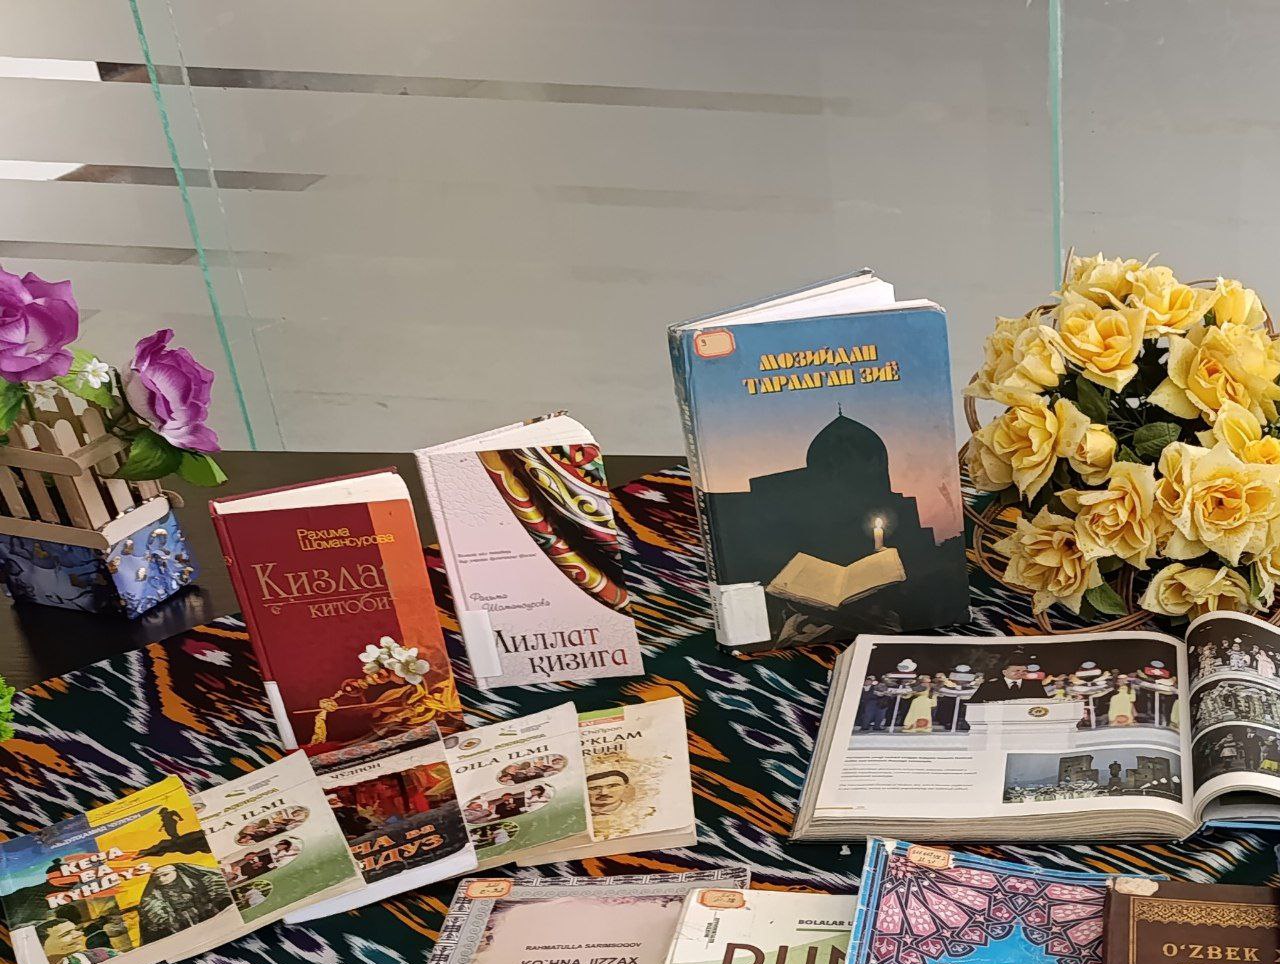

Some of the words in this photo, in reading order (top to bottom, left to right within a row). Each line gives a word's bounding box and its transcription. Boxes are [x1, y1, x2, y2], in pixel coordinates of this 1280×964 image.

[760, 345, 878, 371] МОЗИЙДАН
[742, 369, 855, 395] ТАРАЛГАН
[859, 360, 900, 384] ЗИЁ
[297, 527, 350, 541] Рахима
[300, 533, 395, 551] Шомансурова
[308, 592, 391, 619] китоби
[455, 757, 500, 774] OILA
[507, 744, 549, 760] ILMI
[582, 744, 624, 757] RUHI
[203, 820, 233, 836] ILA
[241, 798, 286, 821] ILMI
[349, 835, 396, 855] ЧА
[357, 834, 446, 872] НДУЗ
[60, 847, 123, 877] КЕЧА
[80, 864, 113, 884] ВА
[46, 862, 153, 909] КУНДУЗ
[1162, 943, 1261, 962] O'ZBEK
